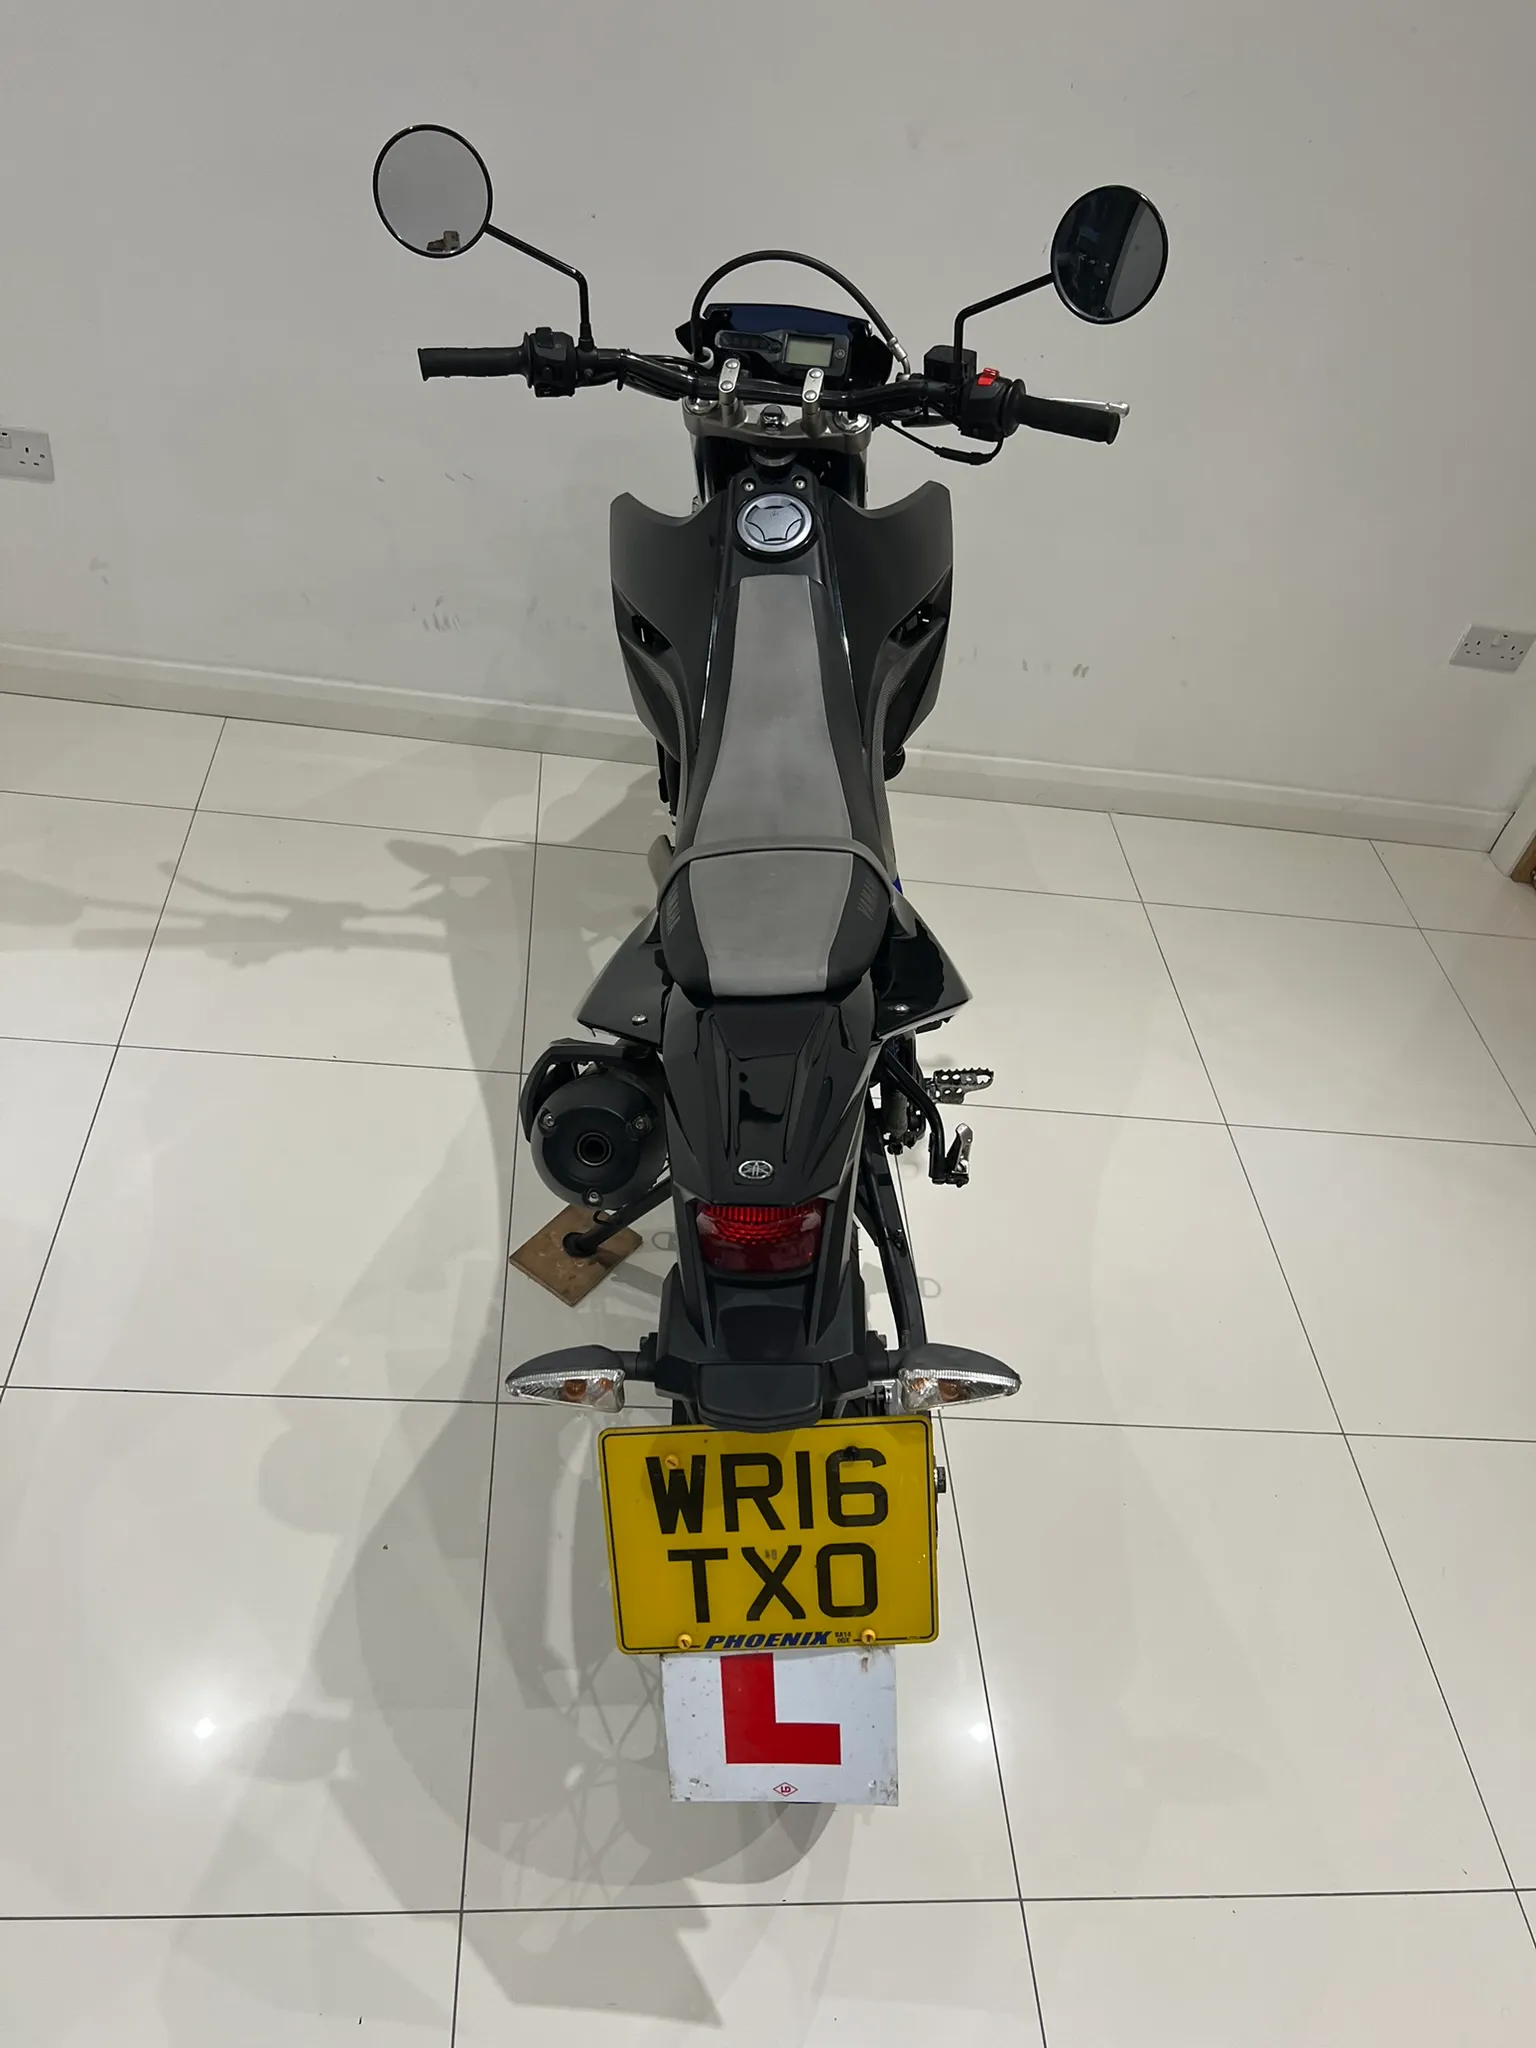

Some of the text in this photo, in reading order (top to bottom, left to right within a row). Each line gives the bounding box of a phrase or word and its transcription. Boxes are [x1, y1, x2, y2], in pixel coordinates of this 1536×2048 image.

[645, 1447, 889, 1534] WR16
[667, 1542, 879, 1623] TXO
[704, 1630, 833, 1649] PHOENIX
[720, 1652, 842, 1765] L
